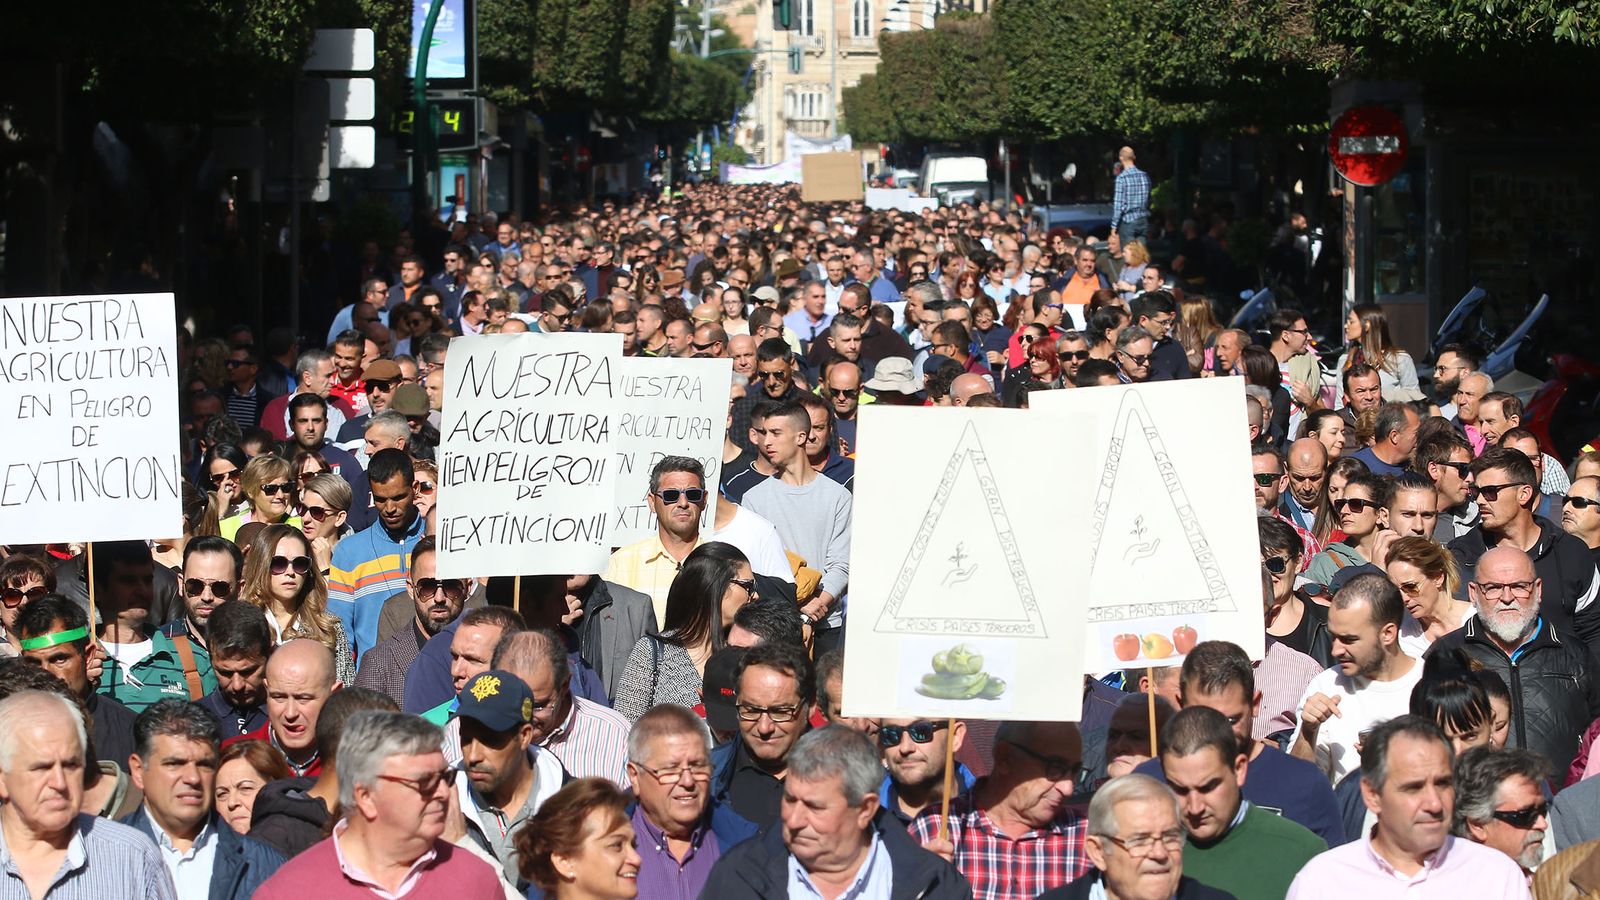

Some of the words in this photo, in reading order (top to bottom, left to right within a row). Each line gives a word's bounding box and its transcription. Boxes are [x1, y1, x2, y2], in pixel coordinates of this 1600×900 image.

[3, 299, 144, 349] NUESTRA
[456, 351, 613, 400] NUESTRA
[620, 375, 702, 402] UESTRA
[18, 394, 51, 419] EN
[70, 388, 152, 418] PELIGRO
[72, 426, 99, 447] DE
[447, 407, 609, 445] AGRICULTURA
[618, 413, 712, 440] RICULTURA
[616, 452, 636, 474] N
[1100, 436, 1123, 489] EUROPA
[1155, 452, 1181, 494] GRAN
[1, 454, 179, 506] EXTINCION
[517, 484, 547, 500] DE
[978, 476, 1005, 516] GRAN
[1087, 606, 1124, 621] CRISIS
[1169, 600, 1218, 615] TERCEROS
[894, 619, 937, 632] CRISIS
[984, 622, 1036, 634] TERCEROS
